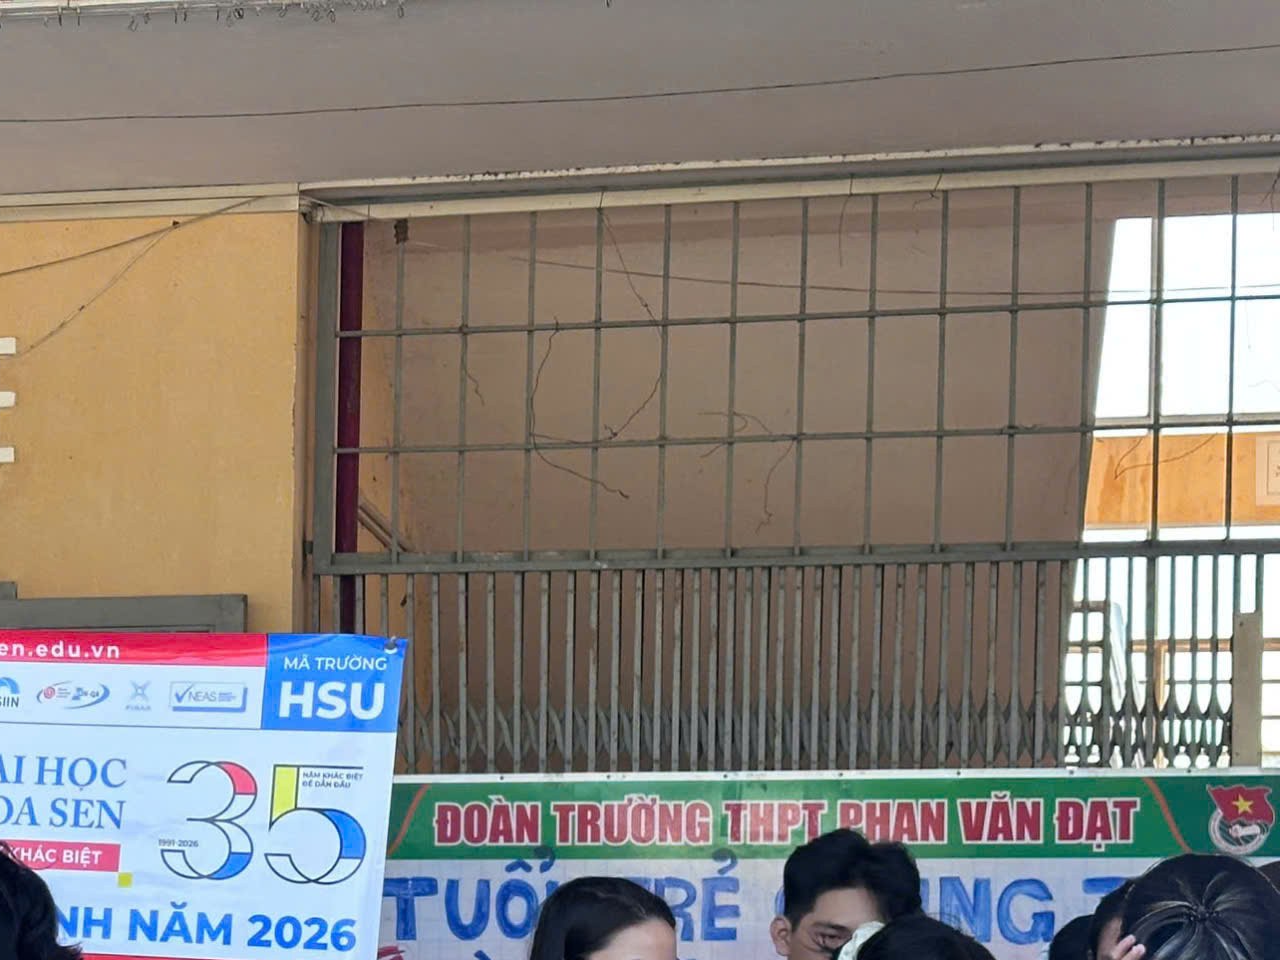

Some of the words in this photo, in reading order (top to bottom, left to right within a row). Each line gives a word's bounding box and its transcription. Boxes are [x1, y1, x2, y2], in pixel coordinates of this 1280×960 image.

[283, 655, 310, 670] MÃ
[315, 654, 387, 671] TRƯỜNG
[188, 691, 217, 702] NEAS
[278, 680, 385, 720] HSU
[34, 755, 128, 792] HỌC
[49, 797, 127, 830] SEN
[432, 795, 541, 846] ĐOÀN
[552, 793, 714, 846] TRƯỜNG
[723, 799, 827, 845] THPT
[836, 799, 948, 844] PHAN
[958, 790, 1043, 845] VĂN
[1053, 796, 1141, 852] ĐẠT
[62, 848, 103, 869] BIỆT
[128, 901, 233, 946] NĂM
[247, 913, 357, 952] 2026
